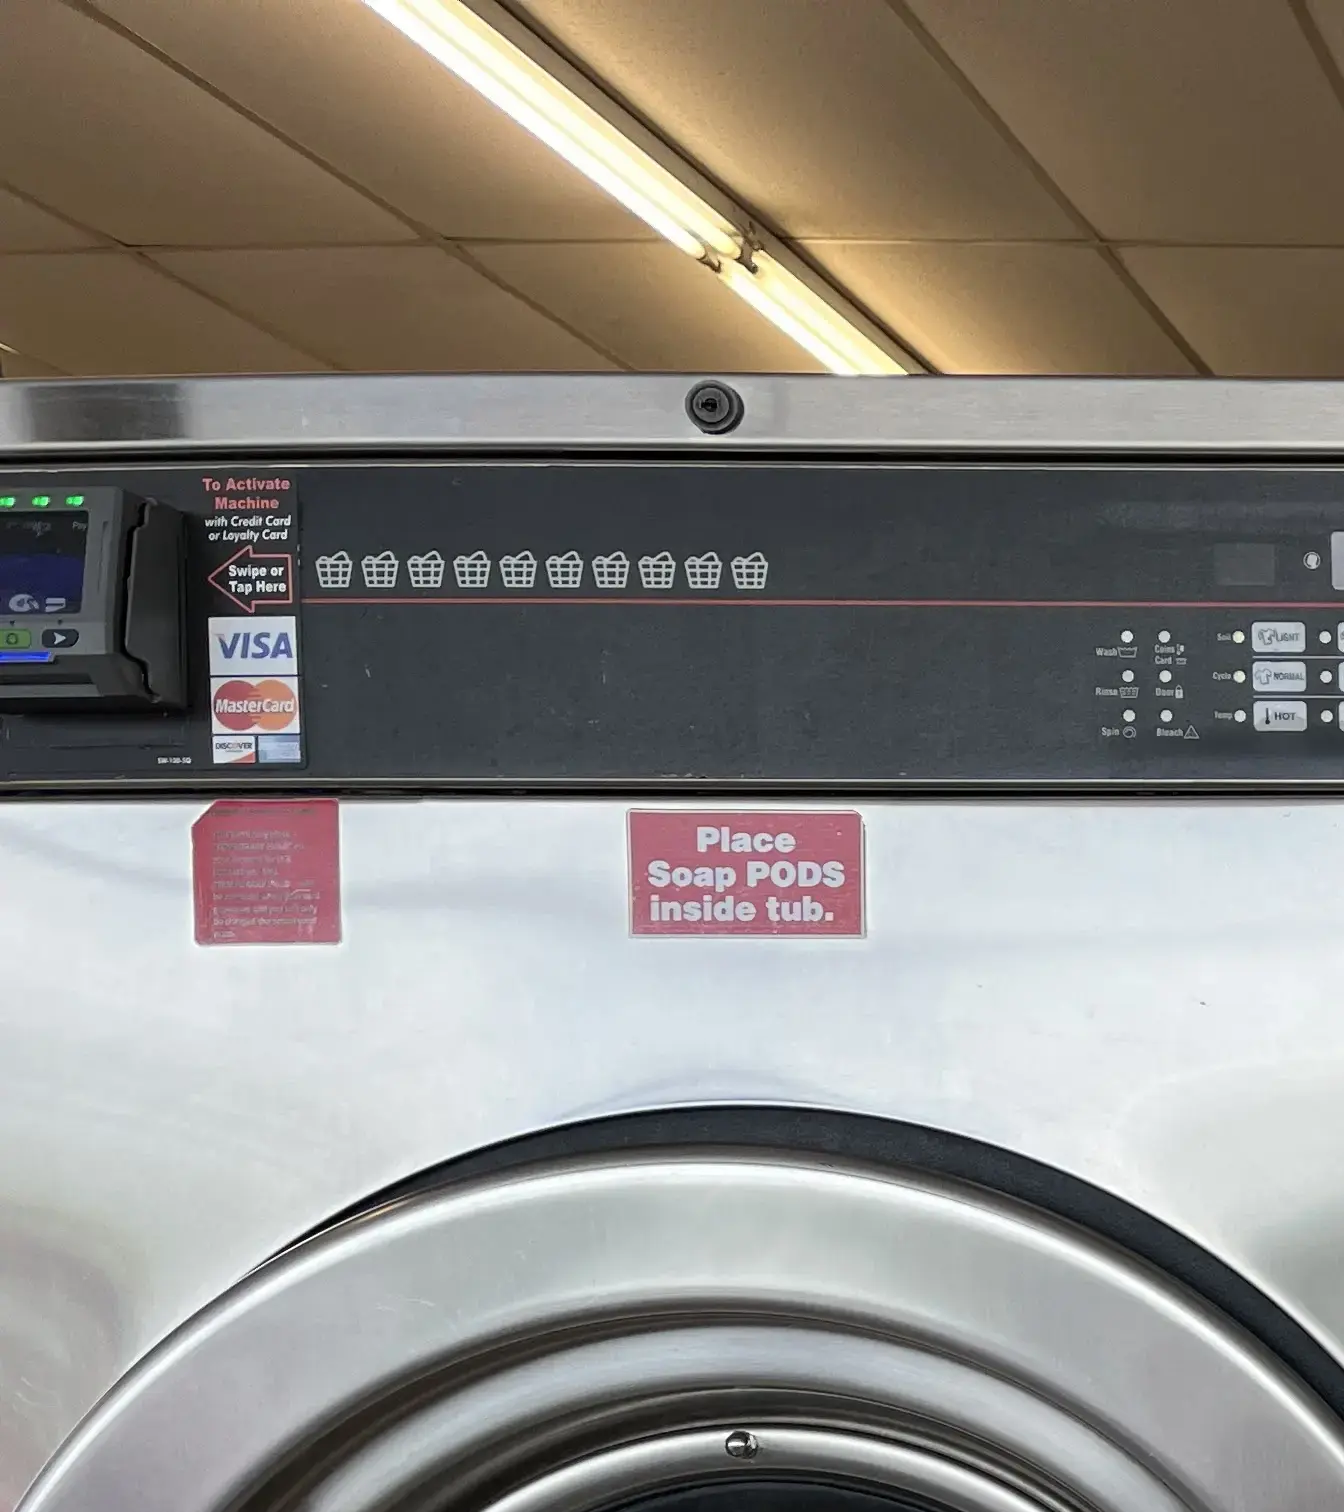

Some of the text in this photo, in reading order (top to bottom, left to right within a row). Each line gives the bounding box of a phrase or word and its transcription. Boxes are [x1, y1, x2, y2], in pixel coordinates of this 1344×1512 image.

[202, 477, 291, 491] To Activate
[214, 496, 280, 510] Machine
[205, 514, 292, 527] with Credit Card
[208, 528, 288, 543] or Loyalty Card
[228, 564, 284, 580] Swipe or
[228, 580, 287, 596] Tap Here
[215, 632, 293, 659] VISA
[1095, 647, 1118, 657] Wash
[1154, 655, 1173, 665] Card
[1273, 672, 1304, 681] NORMAL
[215, 698, 294, 713] MasterCard
[1274, 712, 1296, 720] HOT
[1101, 726, 1120, 737] Spin
[215, 742, 253, 750] DISCOVER
[696, 826, 797, 853] Place
[647, 860, 845, 892] Soap PODS
[650, 894, 834, 922] inside tub.
